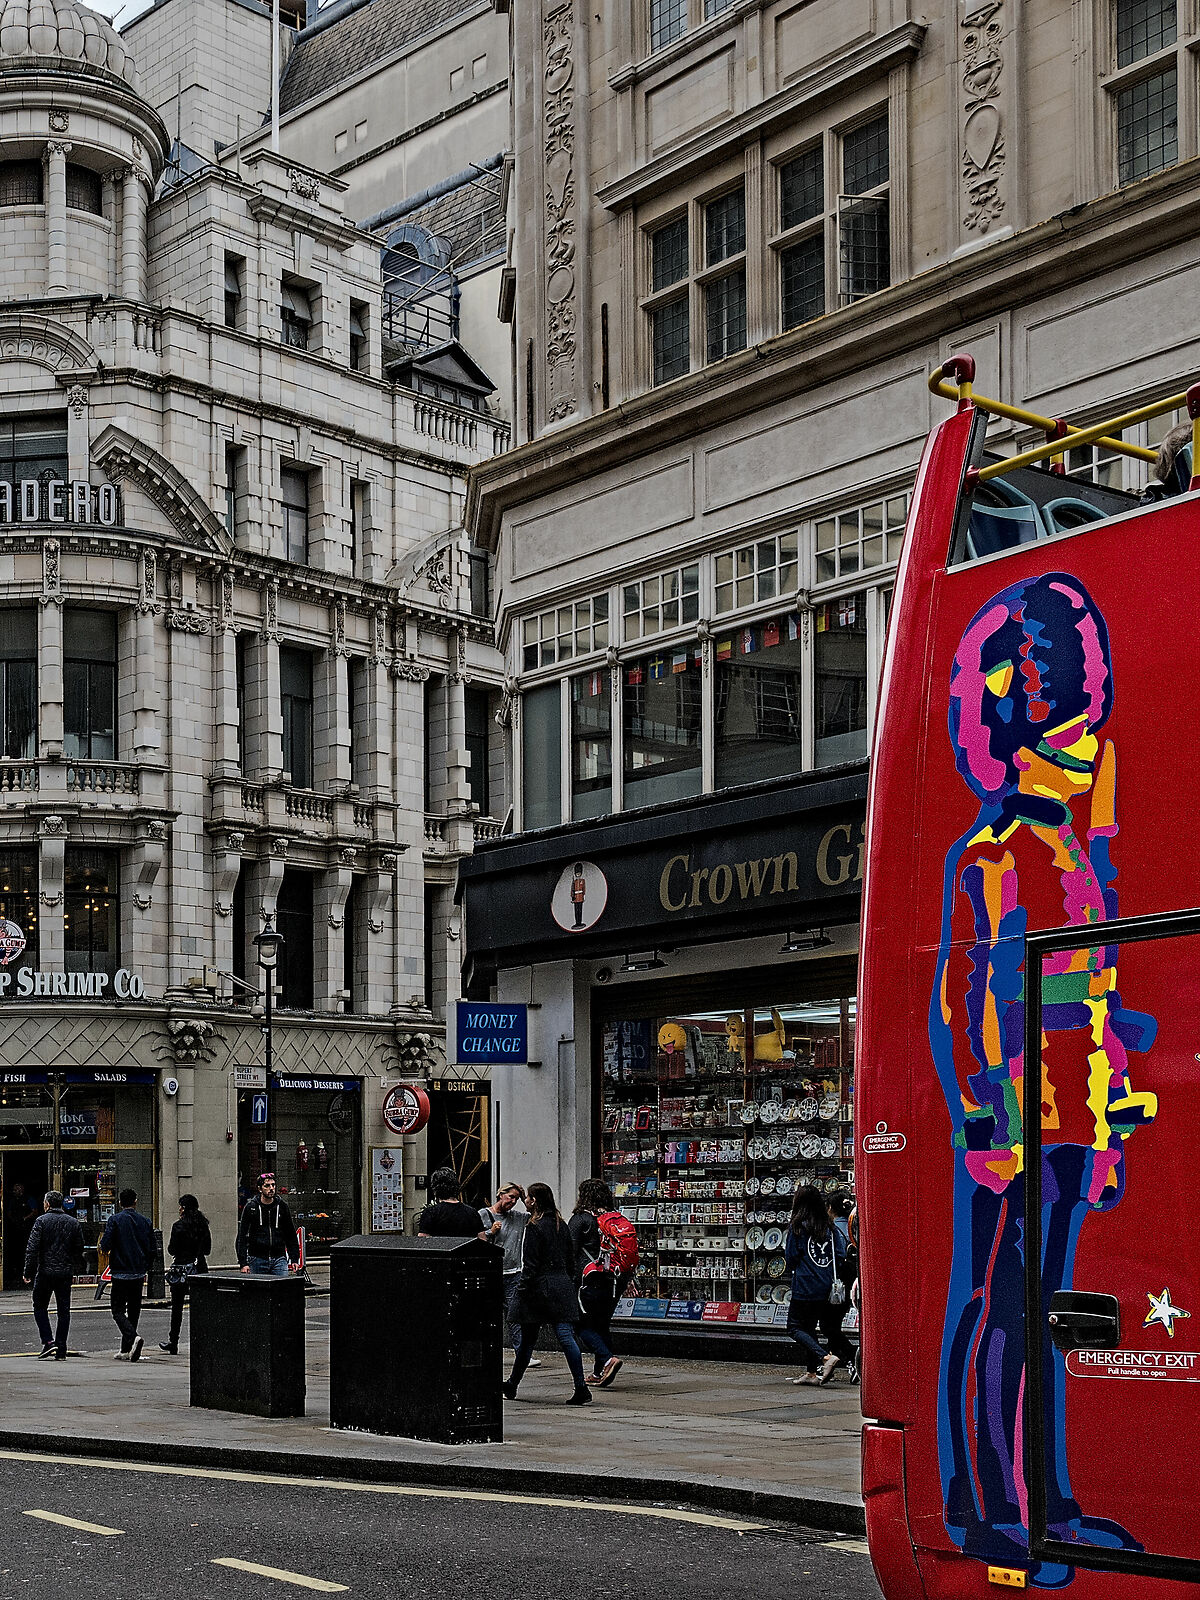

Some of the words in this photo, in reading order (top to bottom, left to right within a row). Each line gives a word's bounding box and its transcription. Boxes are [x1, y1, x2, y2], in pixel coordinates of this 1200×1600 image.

[659, 851, 800, 912] Crown
[5, 938, 25, 947] GUMP
[17, 966, 110, 997] SHRIMP
[465, 1013, 518, 1029] MONEY
[462, 1036, 521, 1053] CHANGE
[4, 1073, 26, 1083] FISH
[94, 1072, 127, 1082] SALADS
[280, 1079, 312, 1088] DELICIOUS
[313, 1080, 345, 1090] DESSERTS
[1078, 1351, 1162, 1366] EMERGENCY
[1165, 1354, 1197, 1367] EXIT
[1107, 1367, 1120, 1375] Pull
[1120, 1368, 1141, 1376] handle
[1150, 1370, 1167, 1378] open
